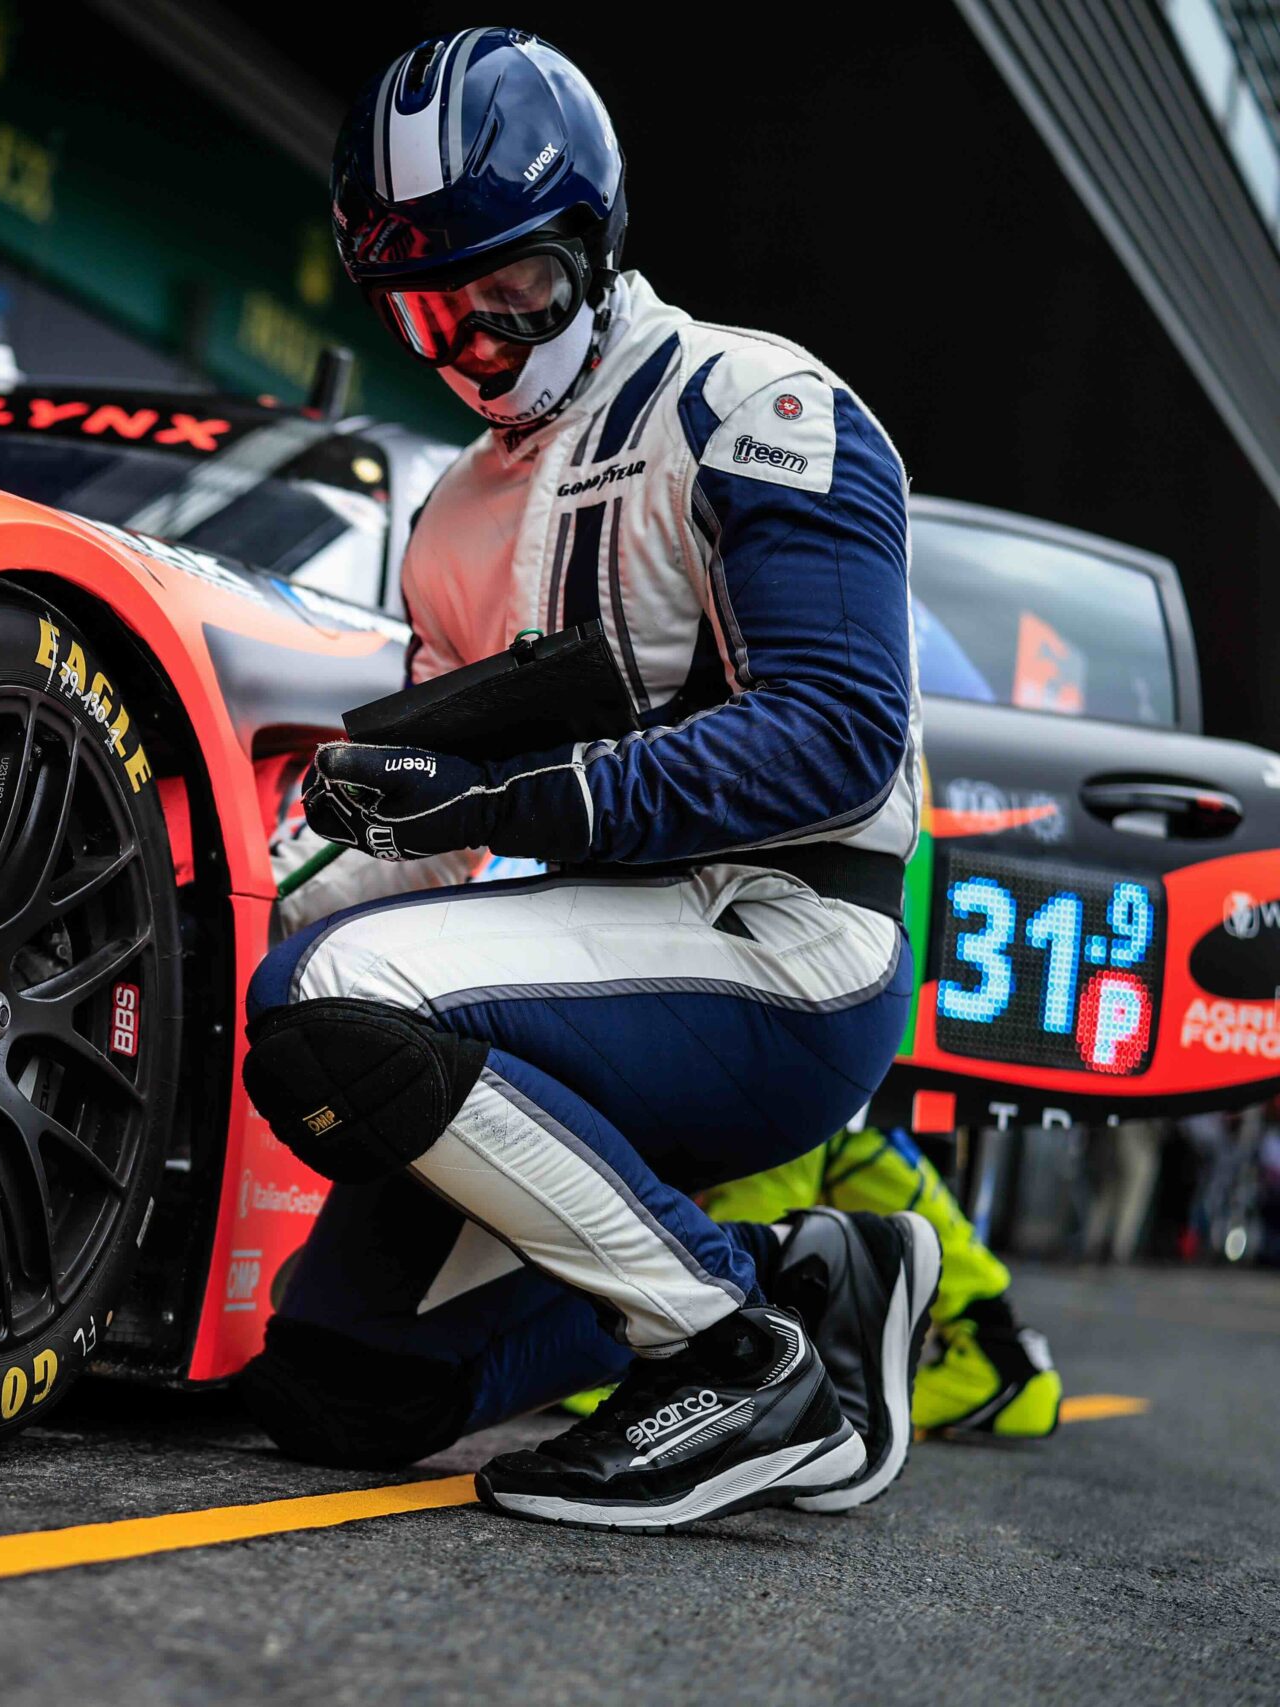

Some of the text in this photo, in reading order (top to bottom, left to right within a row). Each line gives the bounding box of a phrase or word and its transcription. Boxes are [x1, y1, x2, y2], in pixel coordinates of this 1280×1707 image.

[523, 142, 559, 182] uvex
[479, 388, 553, 423] freem
[734, 435, 807, 473] freem
[35, 617, 152, 794] EAGLE
[385, 755, 437, 778] freem
[114, 986, 136, 1054] BBS
[308, 1110, 335, 1132] OMP
[625, 1389, 718, 1450] sparco
